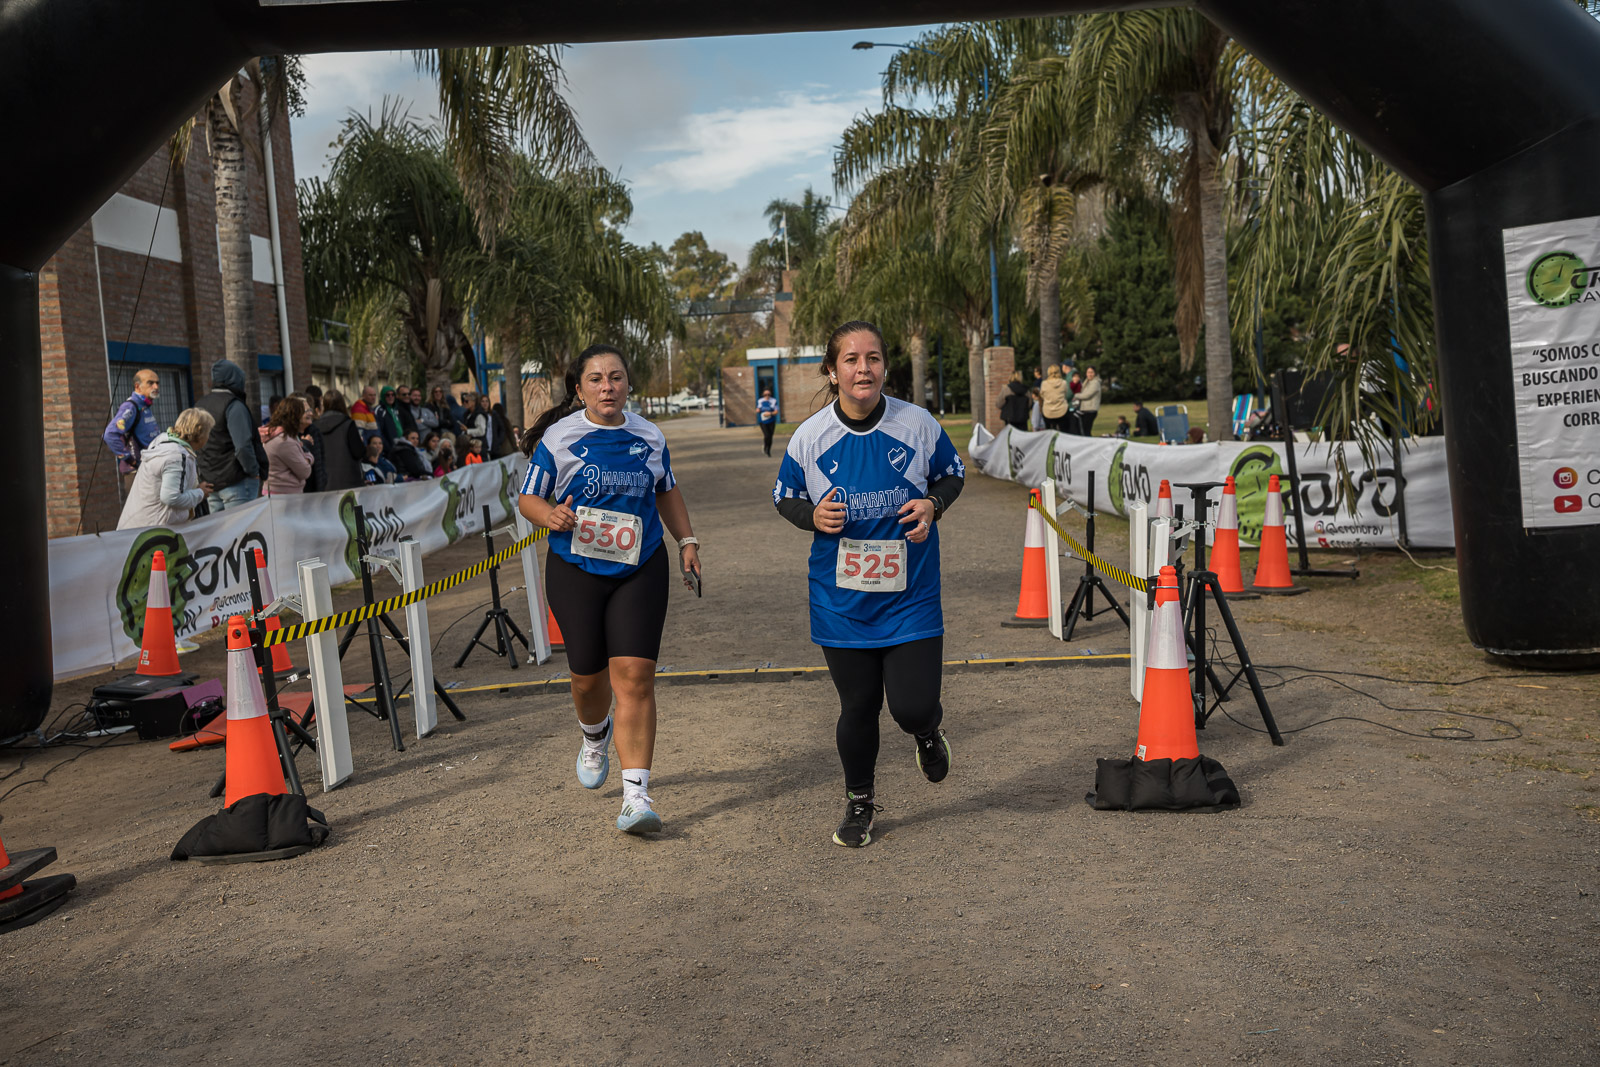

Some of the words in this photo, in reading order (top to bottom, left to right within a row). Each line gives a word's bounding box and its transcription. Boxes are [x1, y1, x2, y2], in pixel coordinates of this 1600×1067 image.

[1592, 343, 1600, 357] C
[1522, 366, 1598, 387] BUSCANDO
[1563, 411, 1600, 428] CORR
[583, 464, 600, 499] 3
[602, 470, 650, 488] MARATÓN
[849, 486, 909, 510] MARATÓN
[578, 520, 636, 551] 530
[843, 552, 900, 579] 525
